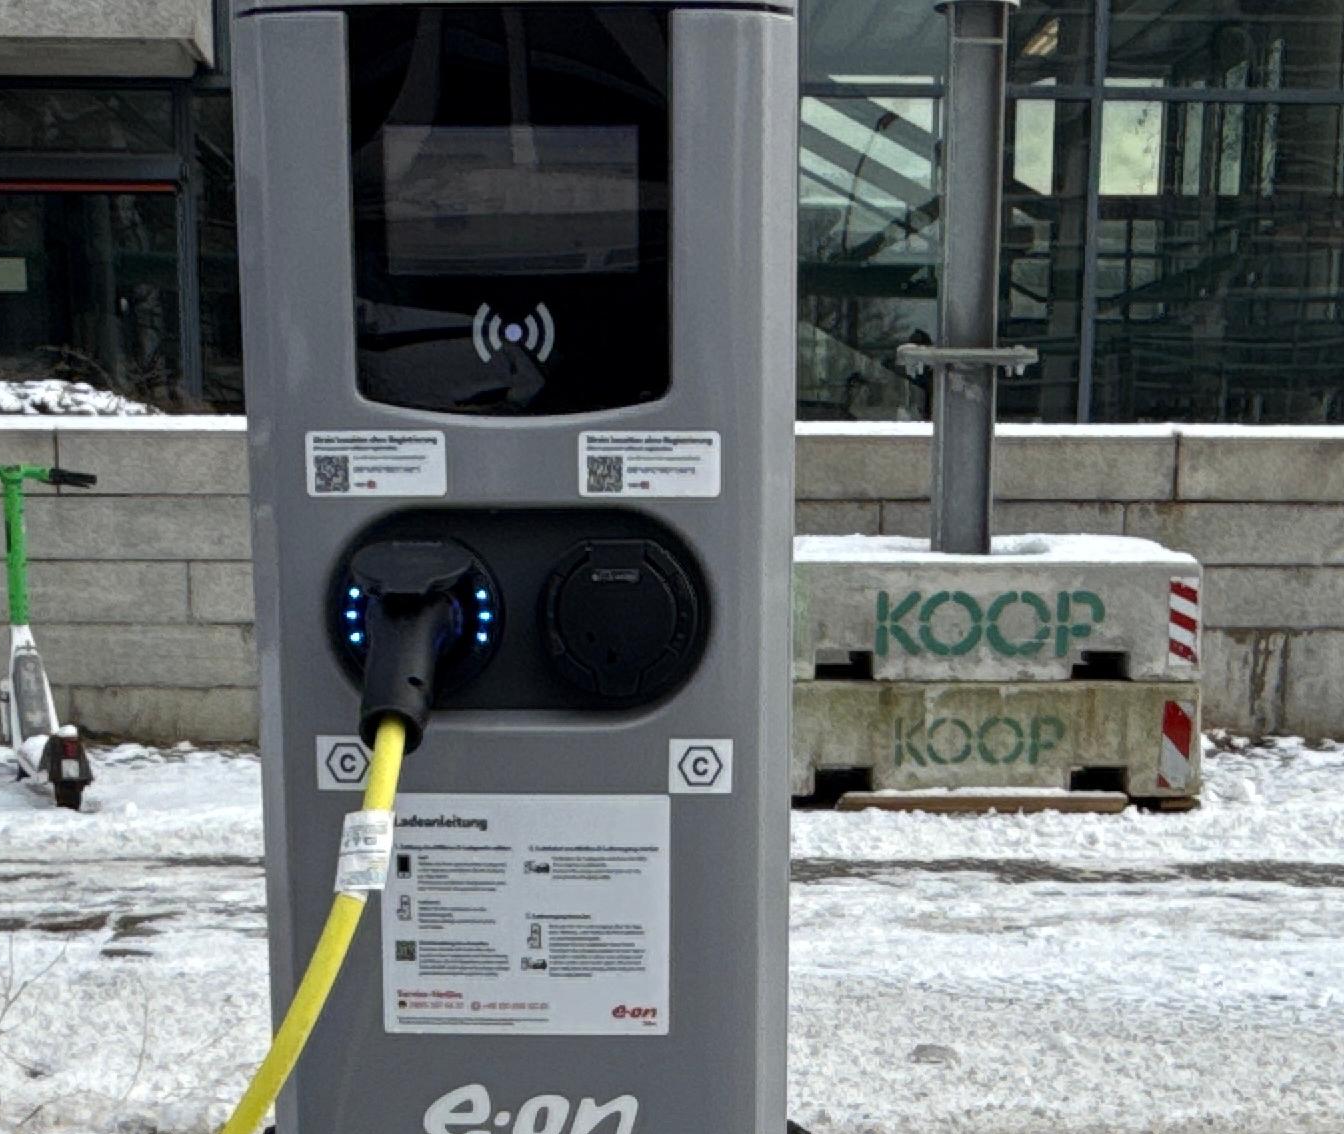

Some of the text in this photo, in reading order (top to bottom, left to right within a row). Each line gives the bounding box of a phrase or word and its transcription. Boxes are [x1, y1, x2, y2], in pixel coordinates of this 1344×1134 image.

[875, 590, 1105, 657] KOOP
[894, 716, 1066, 767] KOOP
[340, 753, 356, 773] C
[692, 756, 709, 776] C
